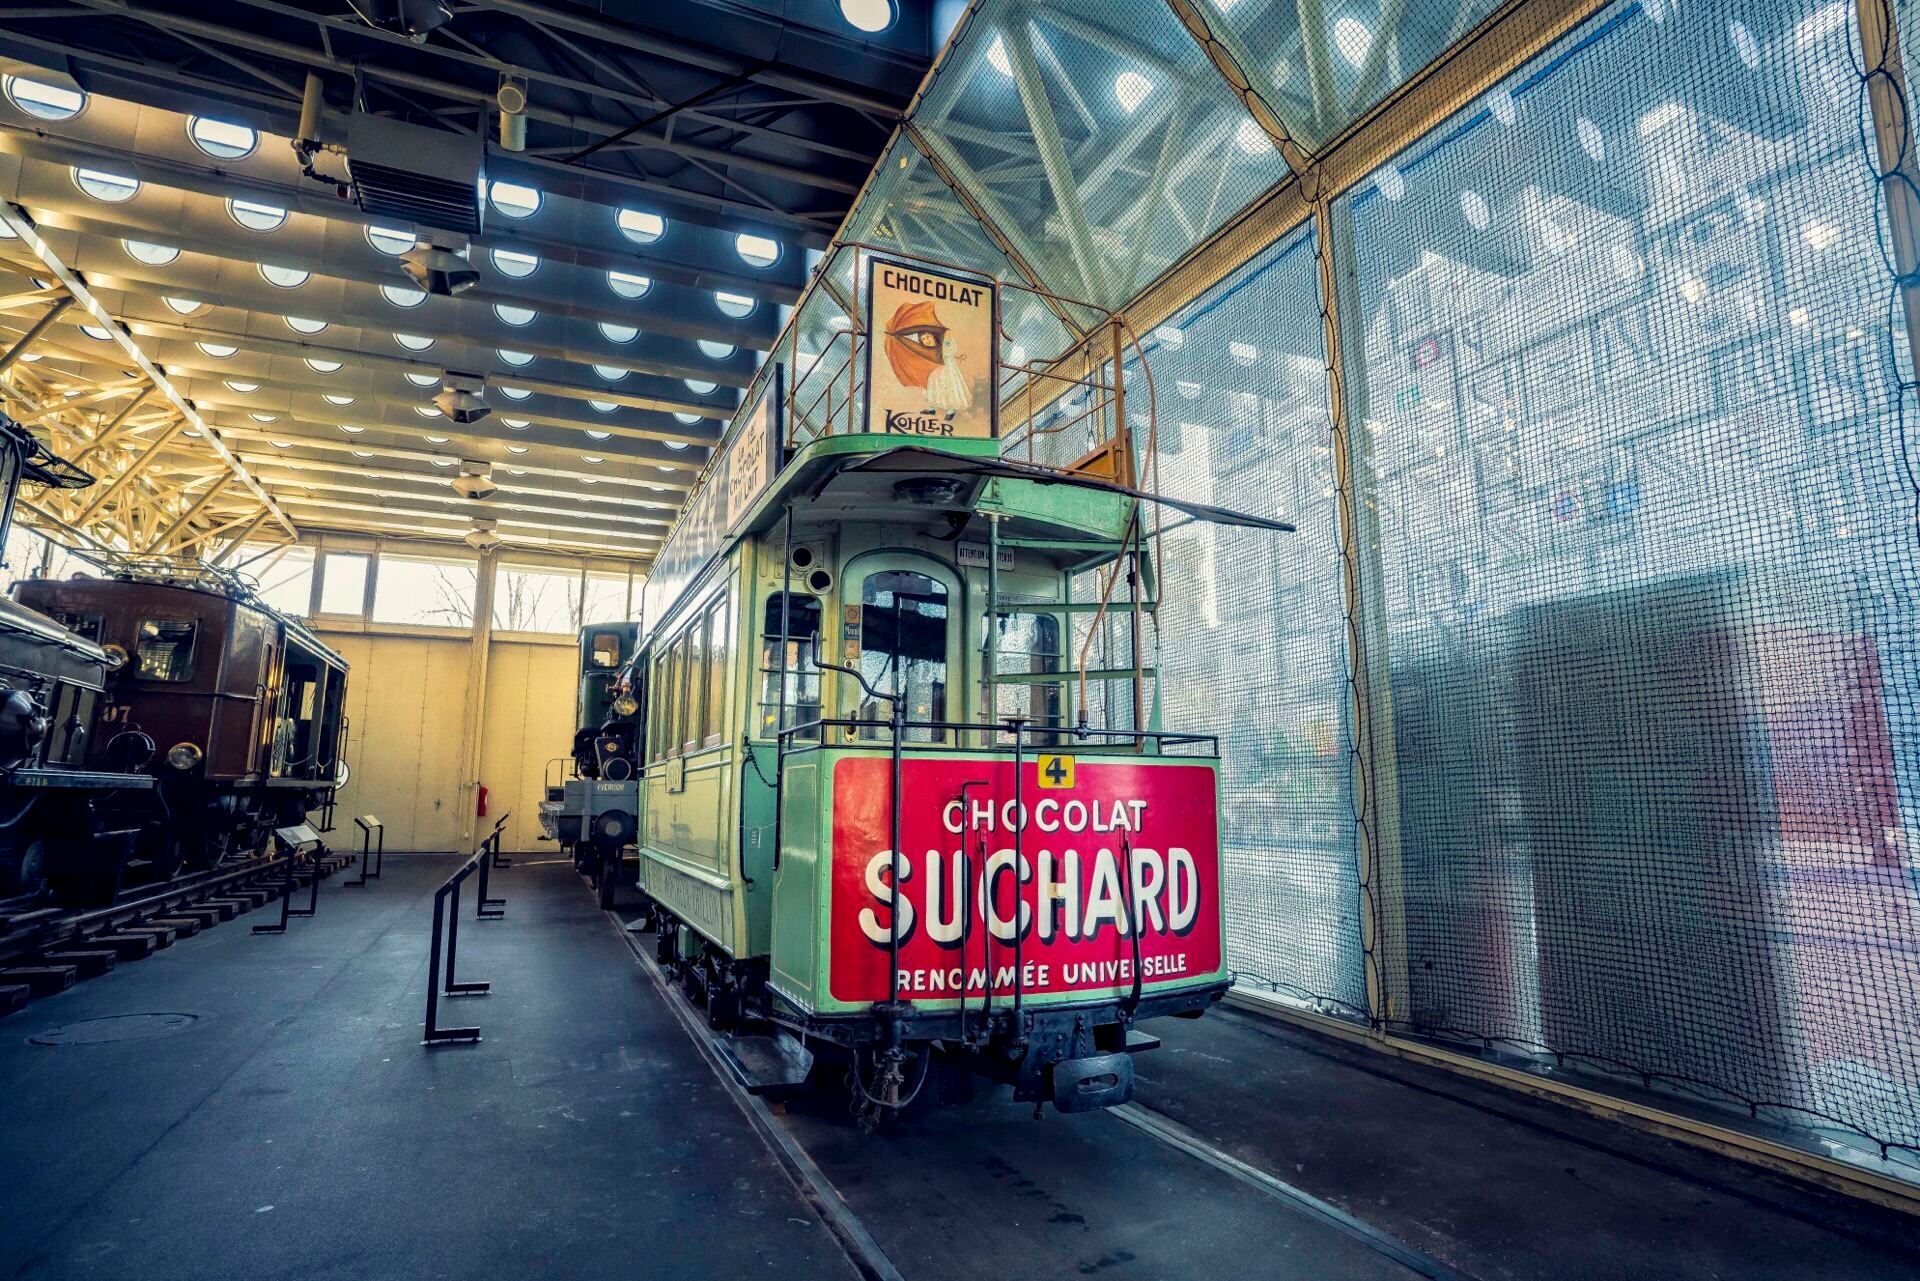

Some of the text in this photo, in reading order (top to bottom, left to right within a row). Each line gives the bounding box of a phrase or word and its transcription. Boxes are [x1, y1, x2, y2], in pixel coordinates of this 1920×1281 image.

[884, 271, 983, 307] CHOCOLAT
[884, 409, 954, 437] KOHLER
[729, 431, 765, 498] CHOCOLAT
[1045, 757, 1068, 785] 4
[943, 799, 1148, 834] CHOCOLAT
[858, 847, 1200, 946] SUCHARD
[897, 960, 1050, 992] RENOMMÉE
